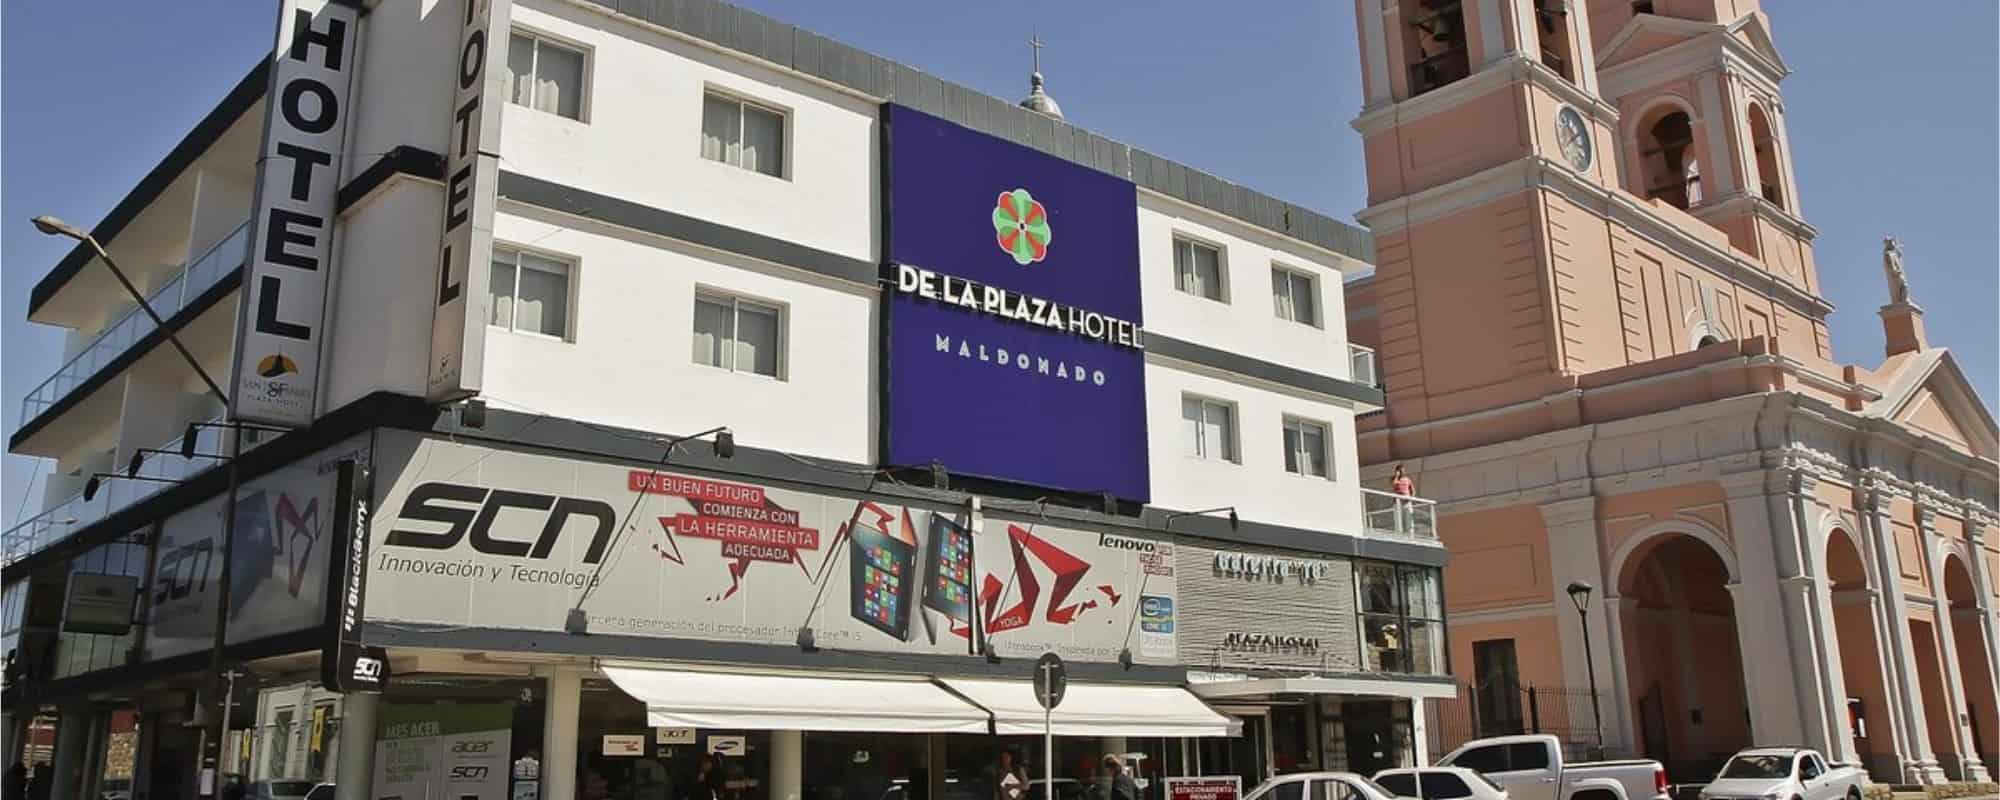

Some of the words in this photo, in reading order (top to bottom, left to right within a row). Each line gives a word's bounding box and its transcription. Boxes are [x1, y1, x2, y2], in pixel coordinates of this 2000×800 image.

[256, 8, 346, 341] HOTEL
[900, 264, 937, 300] DE
[943, 275, 977, 309] LA
[984, 285, 1065, 329] PLAZA
[1068, 306, 1145, 349] HOTEL
[935, 334, 1106, 386] MALDONADO
[636, 475, 657, 490] UN
[663, 478, 701, 495] BUEN
[706, 485, 761, 503] FUTURO
[703, 502, 768, 521] COMIENZA
[770, 510, 796, 525] CON
[680, 519, 700, 534] LA
[705, 521, 814, 545] HERRAMIENTA
[1099, 532, 1154, 553] lenovo
[348, 499, 368, 609] BlackBerry
[724, 543, 790, 561] ADECUADA
[378, 553, 485, 578] Innovación
[490, 566, 502, 582] y
[510, 564, 600, 590] Tecnología
[629, 615, 697, 631] generación
[718, 623, 776, 638] procesador
[999, 614, 1024, 629] YOGA
[452, 740, 495, 753] acer
